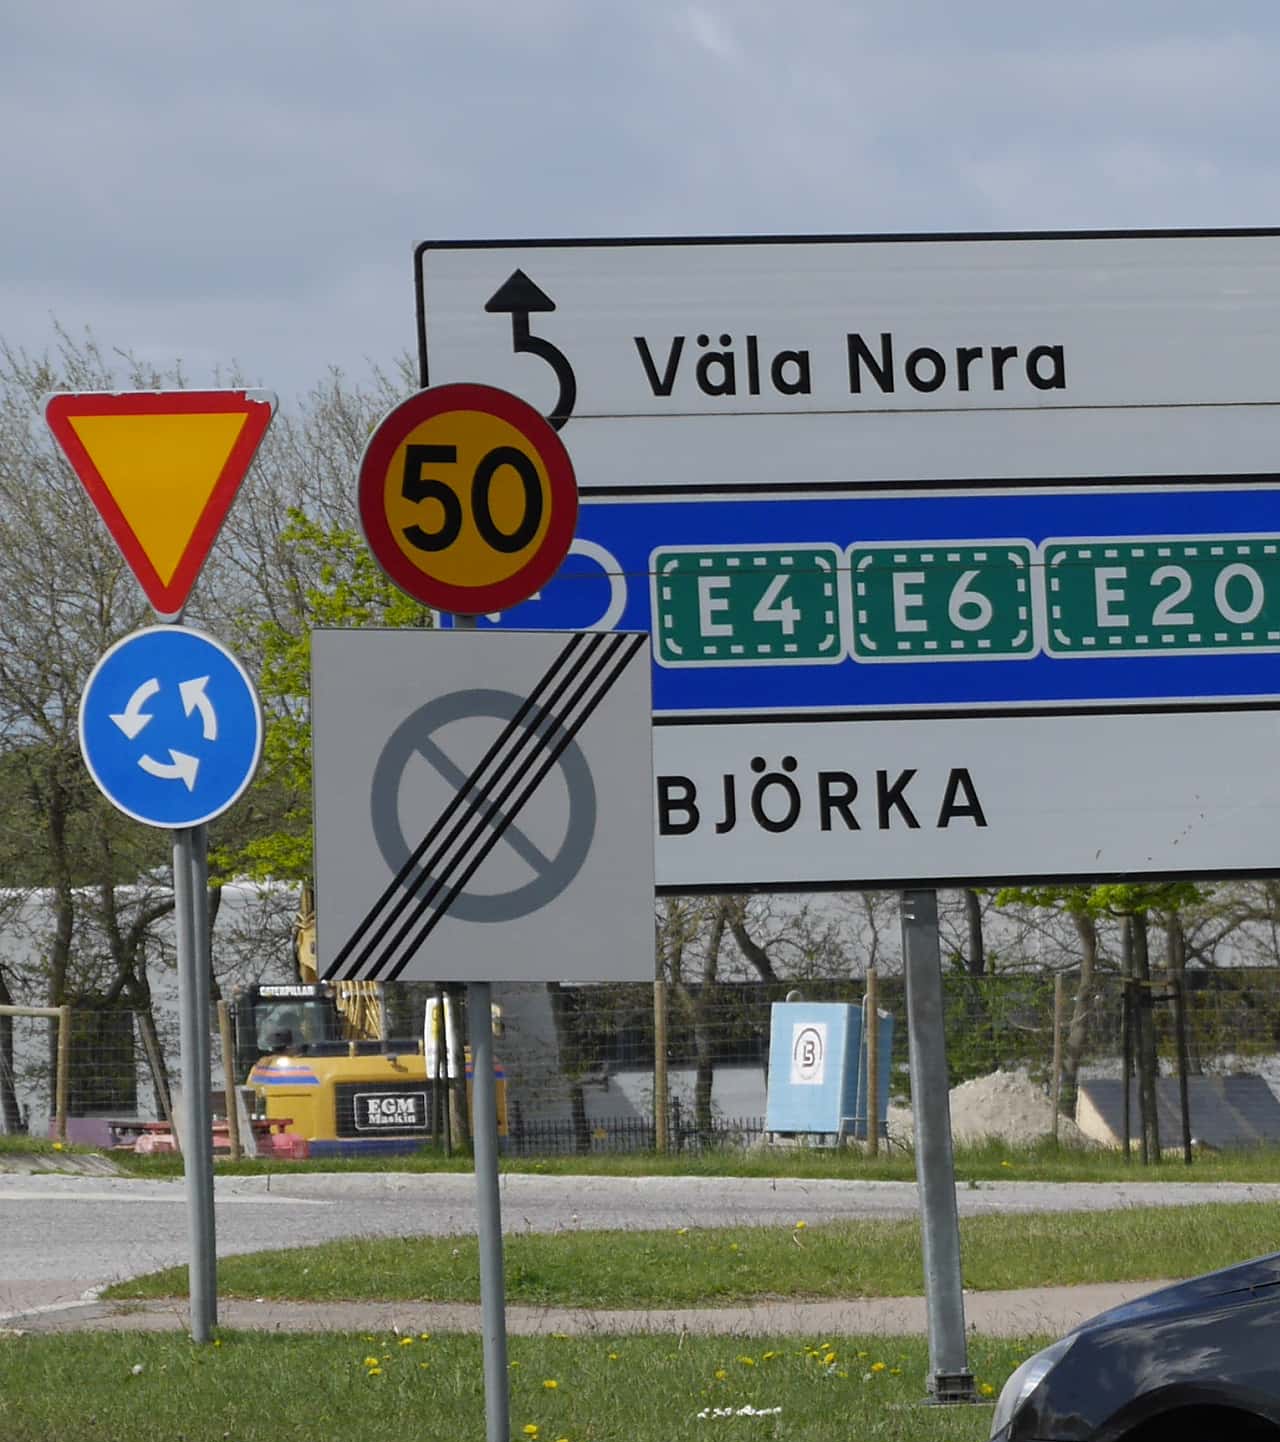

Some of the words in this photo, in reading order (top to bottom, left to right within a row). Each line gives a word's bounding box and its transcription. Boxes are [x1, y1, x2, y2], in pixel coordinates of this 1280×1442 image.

[634, 333, 811, 397] Väla
[847, 332, 1067, 395] Norra
[400, 444, 544, 554] 50
[697, 572, 802, 638] E4
[891, 568, 994, 633] E6
[1093, 563, 1267, 629] E20
[656, 755, 989, 836] BJÖRKA
[367, 1097, 416, 1114] EGM
[367, 1111, 417, 1125] Maskin
